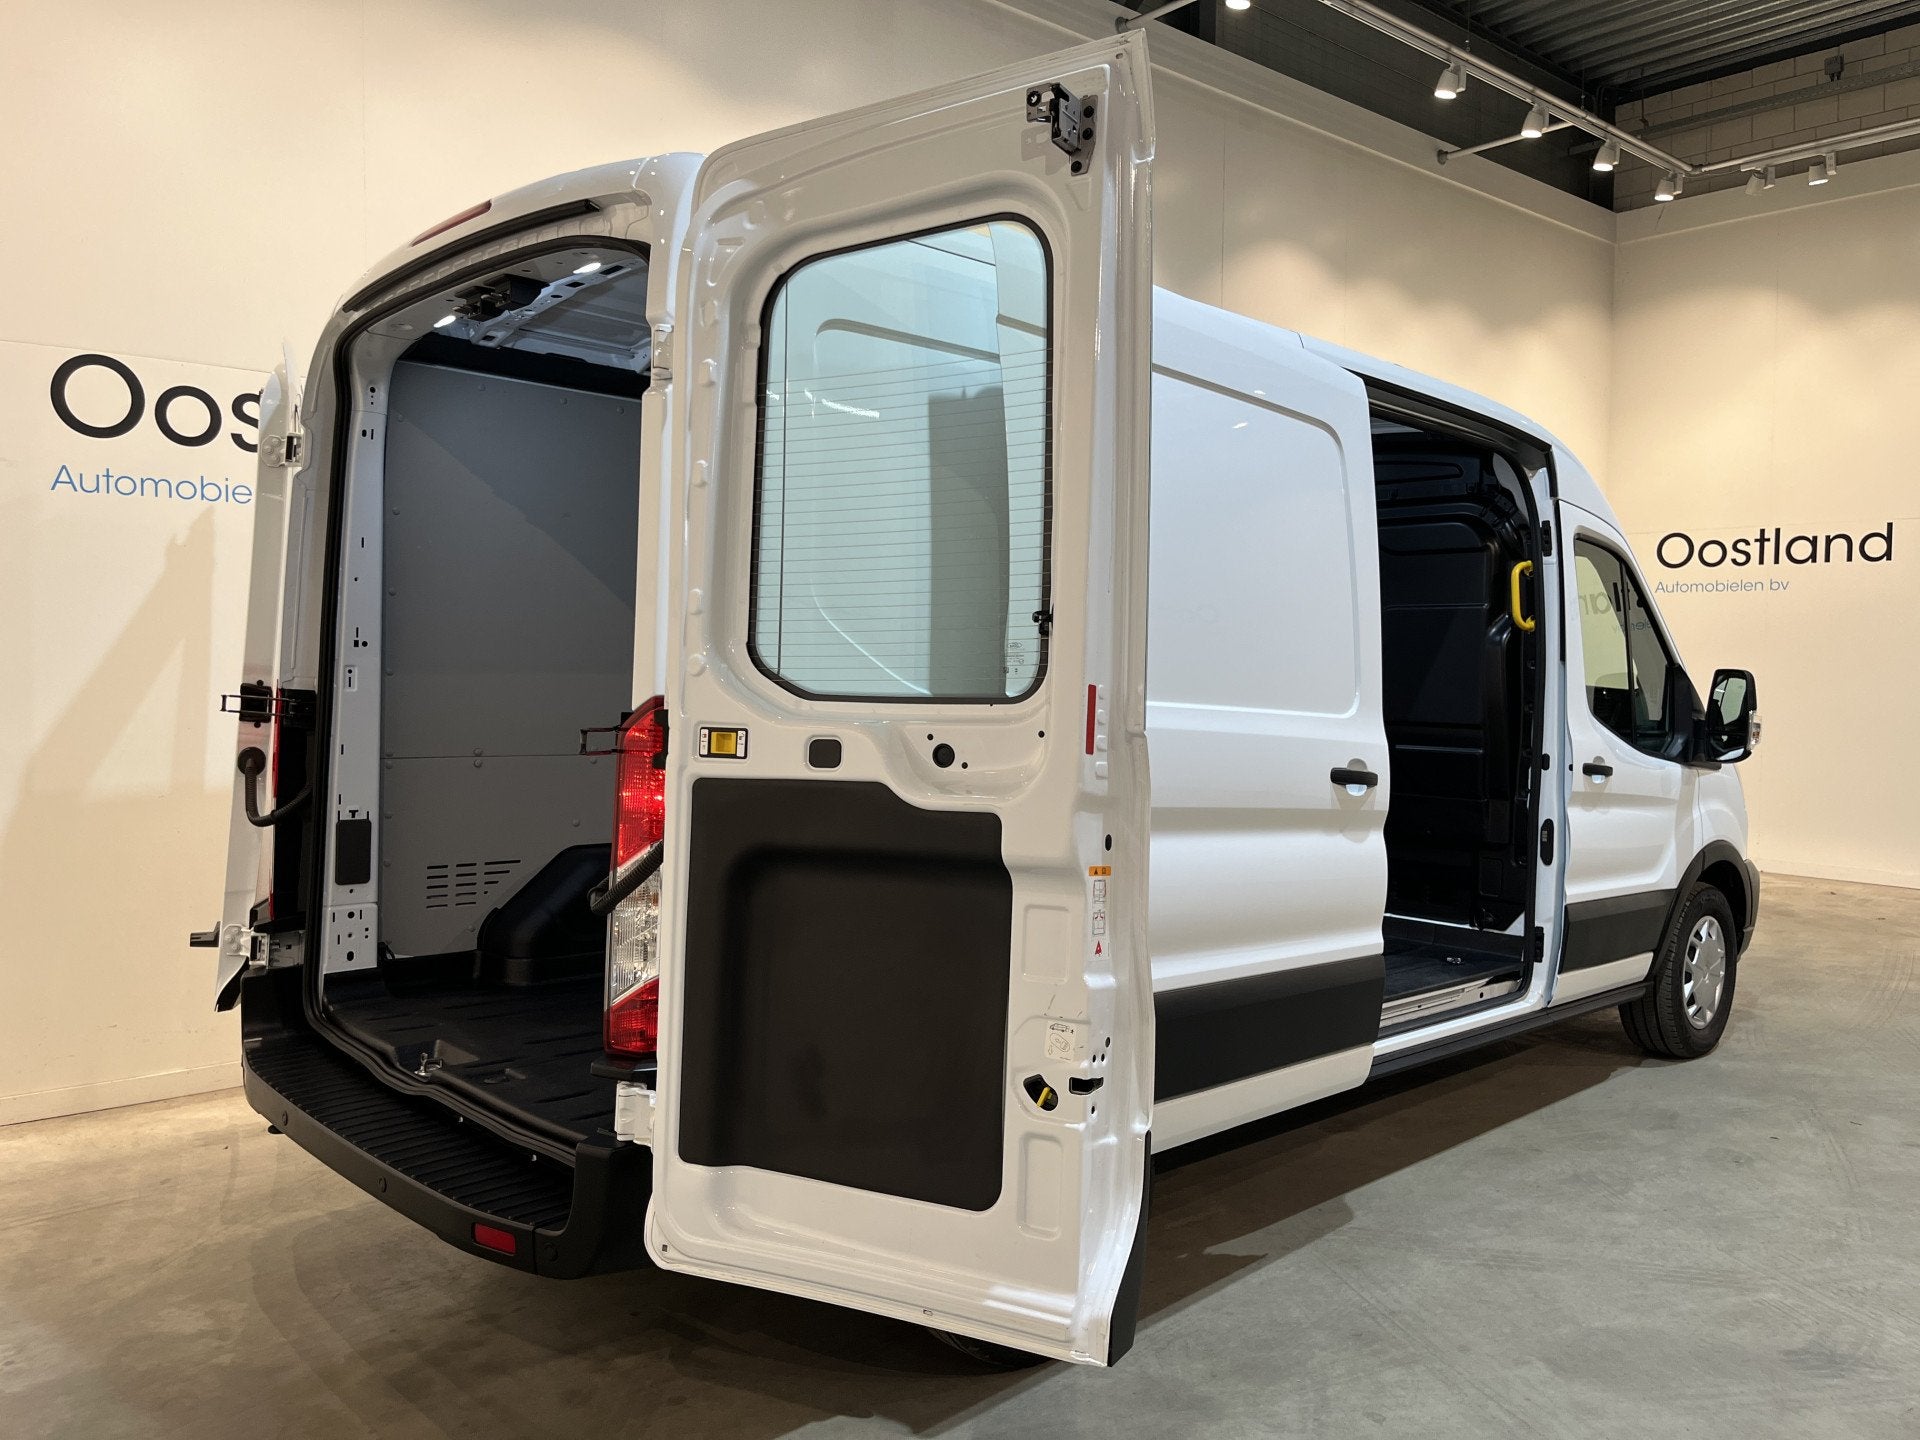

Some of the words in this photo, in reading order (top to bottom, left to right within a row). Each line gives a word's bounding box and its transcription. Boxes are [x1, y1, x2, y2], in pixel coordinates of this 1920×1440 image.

[50, 464, 252, 504] Automobie
[1656, 522, 1893, 569] Oostland
[1655, 579, 1764, 594] Automobielen
[1769, 578, 1790, 592] bv
